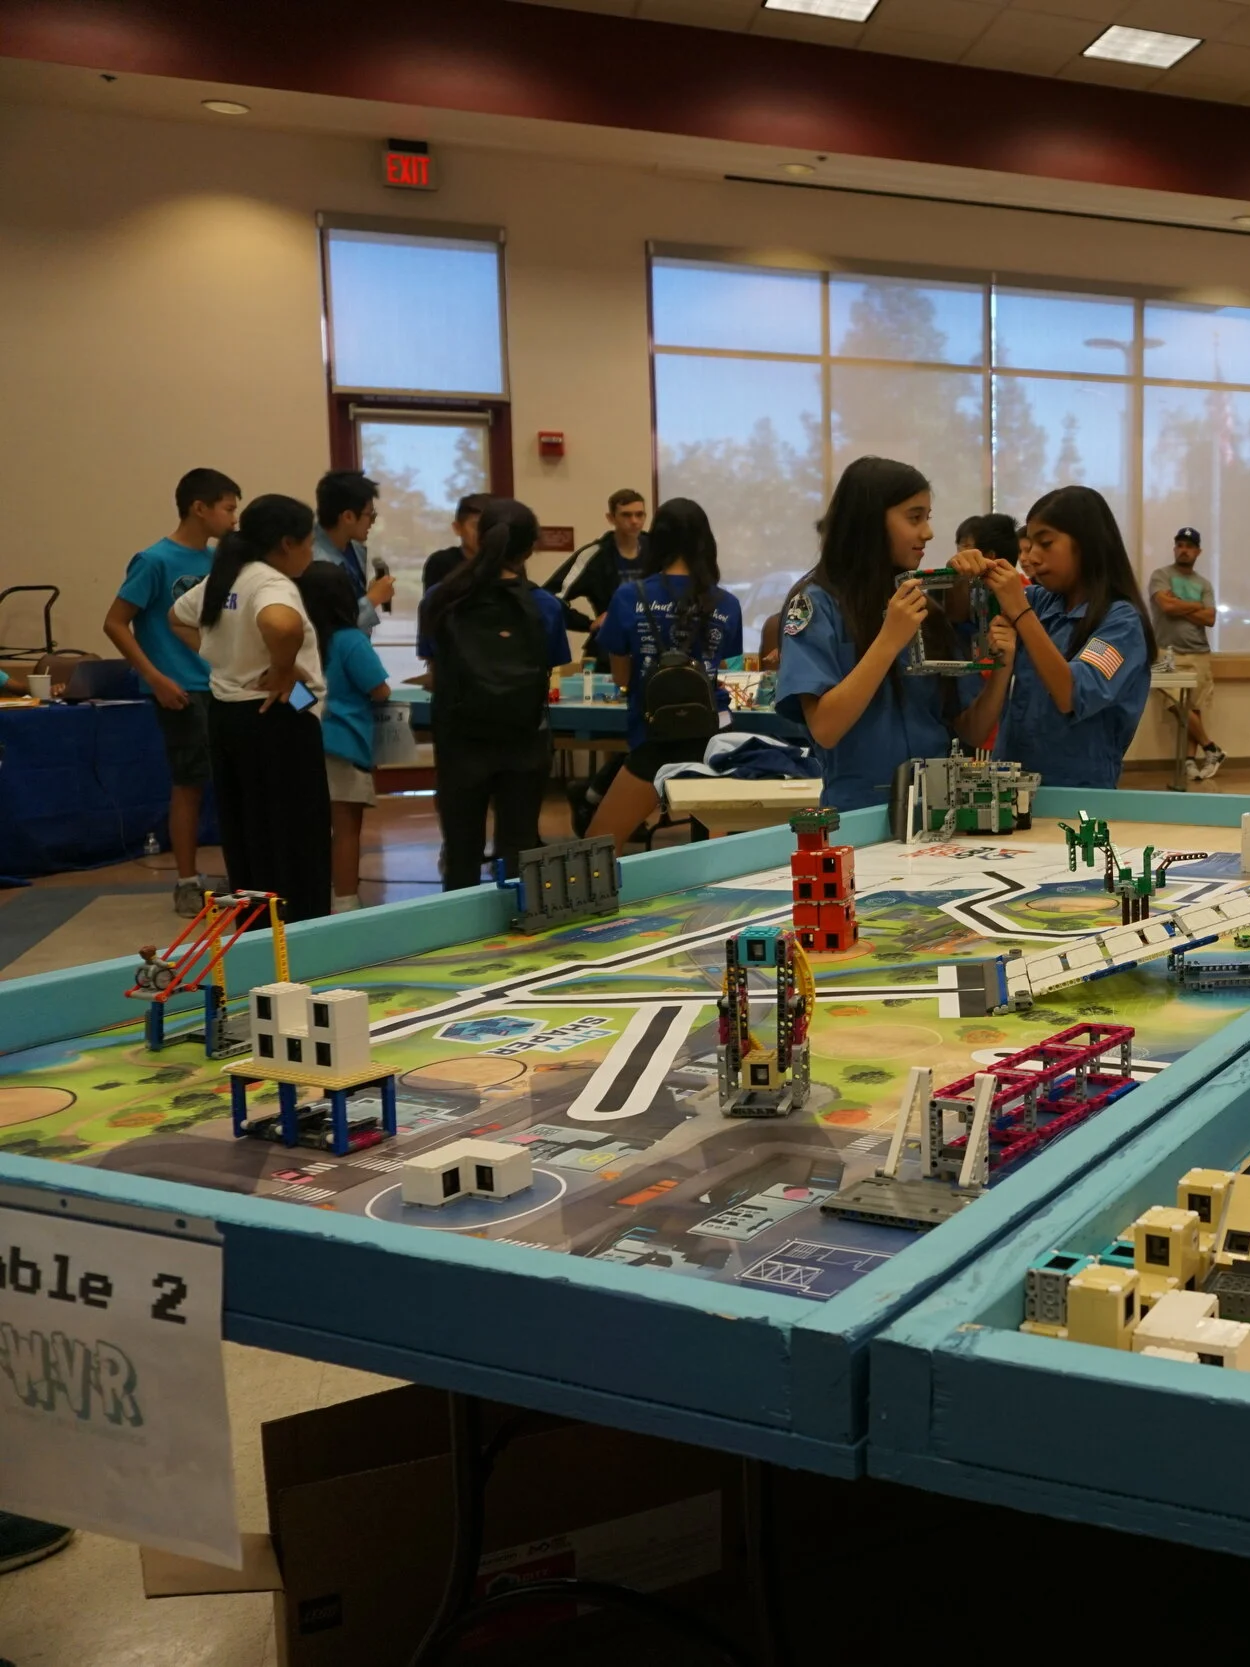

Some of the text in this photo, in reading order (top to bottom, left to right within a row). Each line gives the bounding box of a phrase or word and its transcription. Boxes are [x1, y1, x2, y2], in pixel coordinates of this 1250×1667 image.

[386, 152, 431, 186] EXIT
[487, 1016, 608, 1056] SHAPER
[545, 1028, 614, 1052] CITY
[151, 1272, 187, 1325] 2
